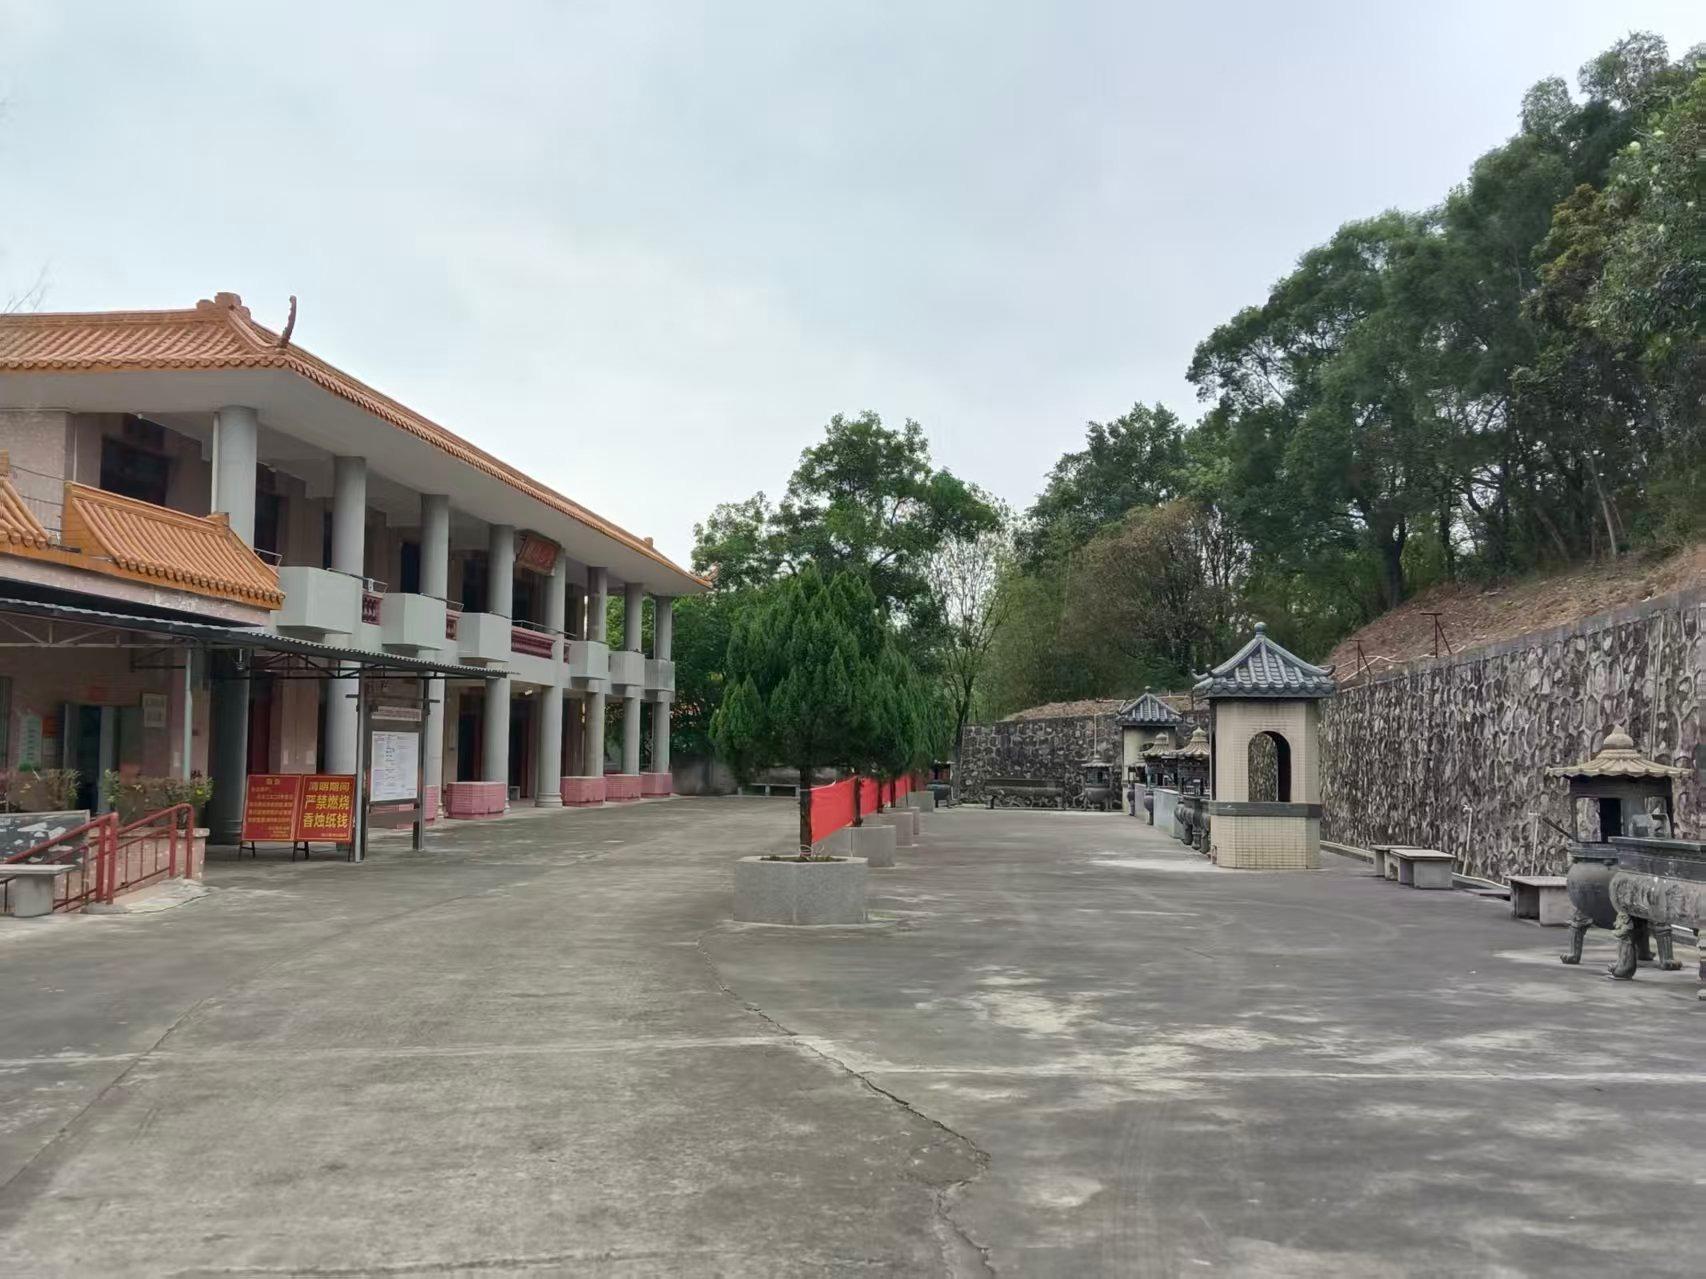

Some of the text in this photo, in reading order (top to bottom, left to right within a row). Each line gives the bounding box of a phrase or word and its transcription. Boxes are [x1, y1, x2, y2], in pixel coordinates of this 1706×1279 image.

[305, 795, 350, 810] 严禁燃烧
[303, 813, 348, 828] 香烛纸钱
